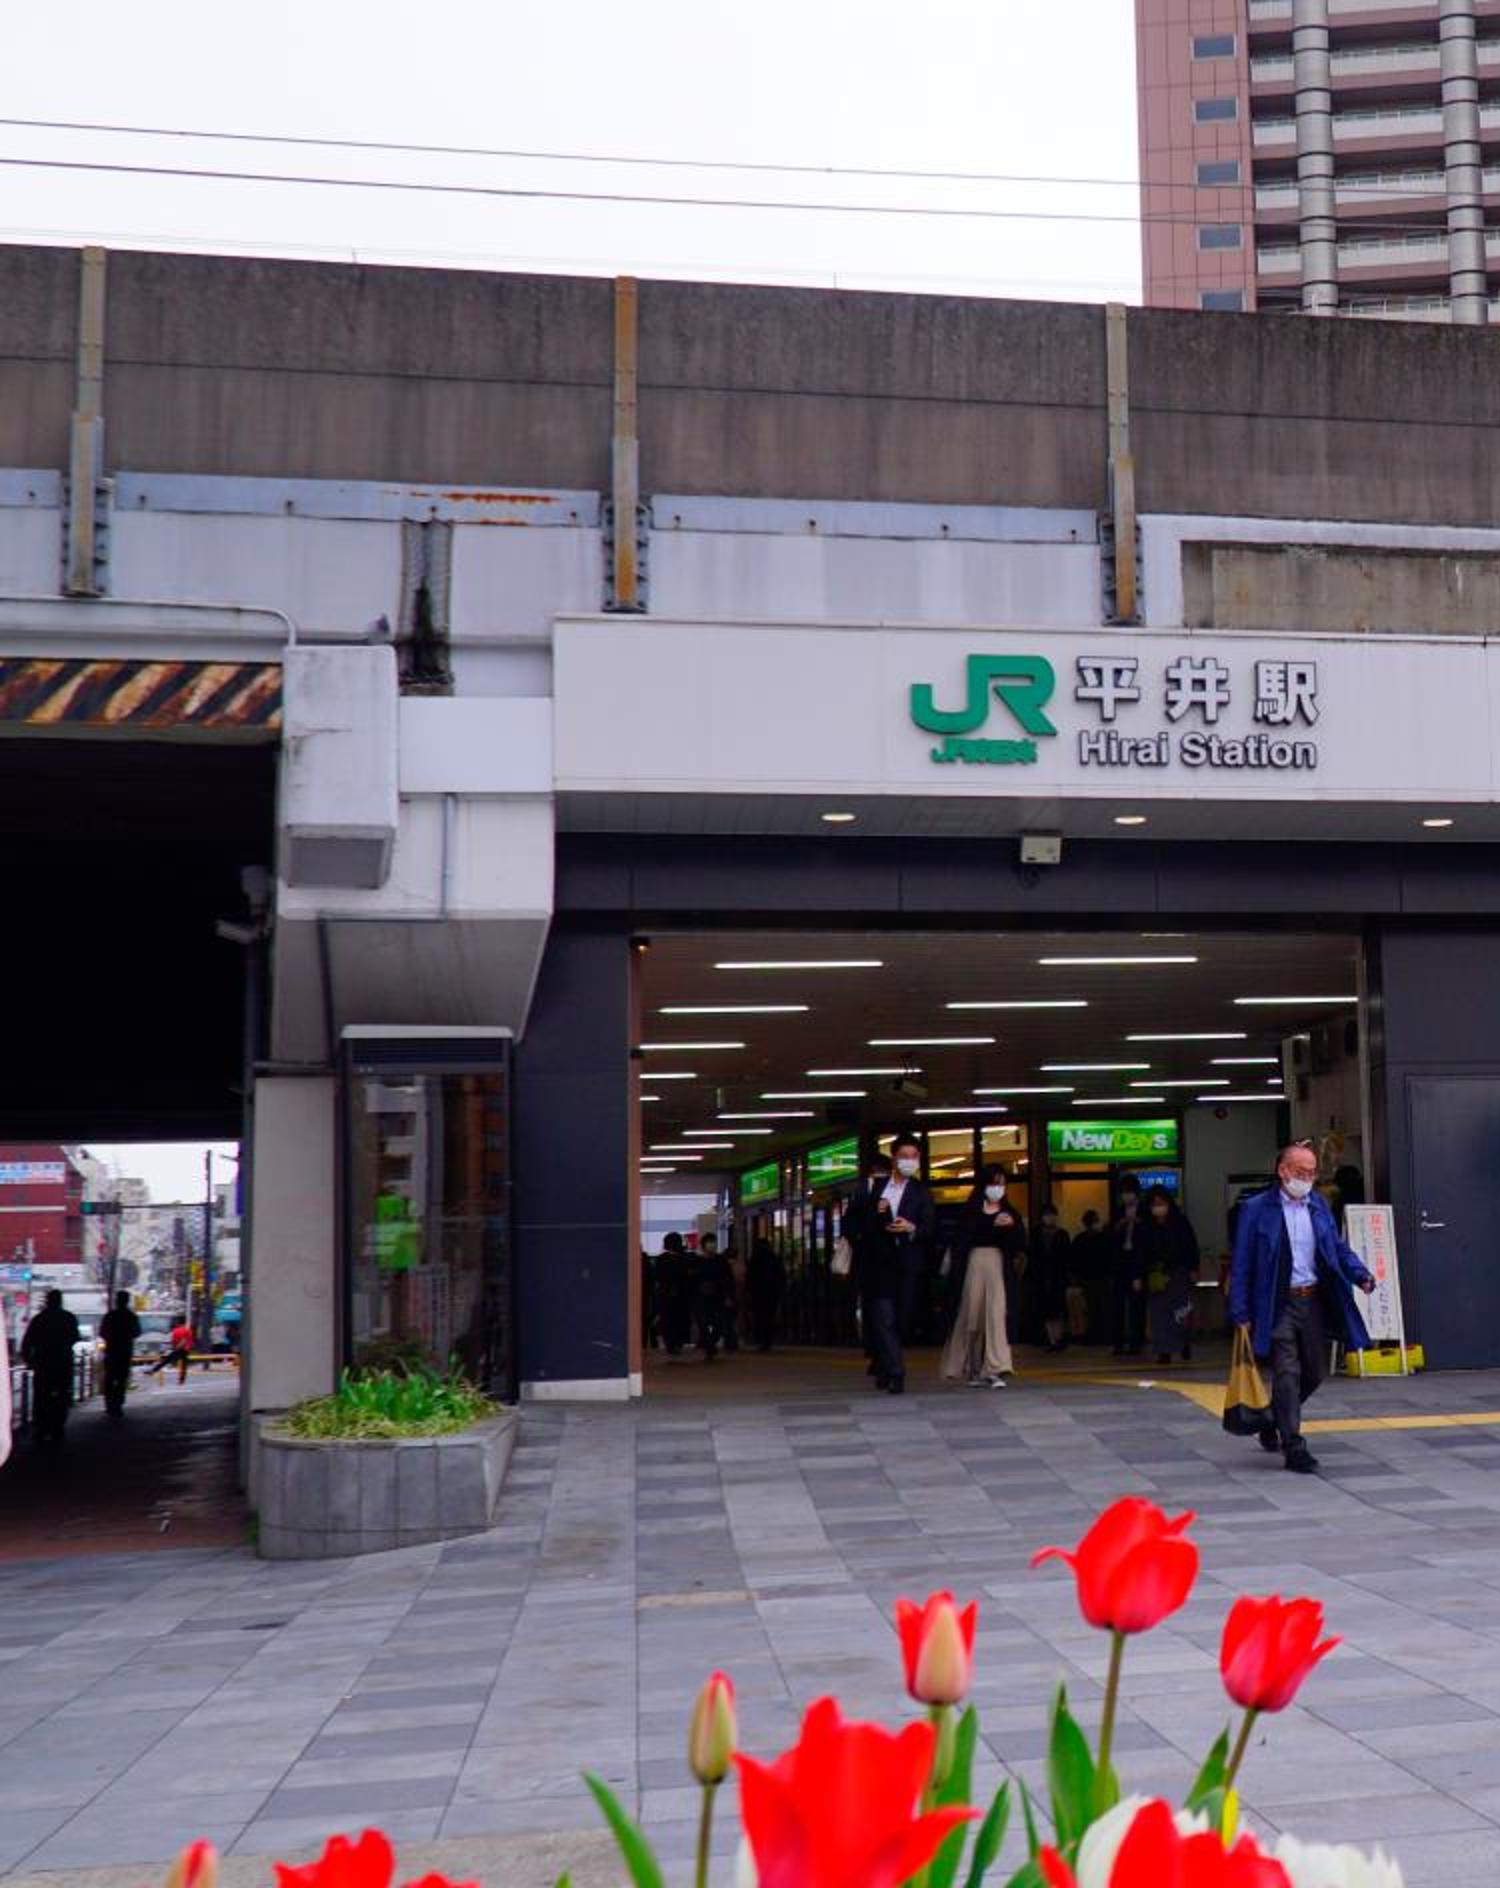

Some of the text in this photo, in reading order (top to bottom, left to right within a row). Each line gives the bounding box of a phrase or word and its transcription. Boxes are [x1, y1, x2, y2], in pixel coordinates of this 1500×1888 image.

[910, 654, 1057, 736] JR
[1076, 656, 1320, 726] 平井駅
[1079, 731, 1317, 769] Hirai Station
[1061, 1129, 1168, 1152] NewDays
